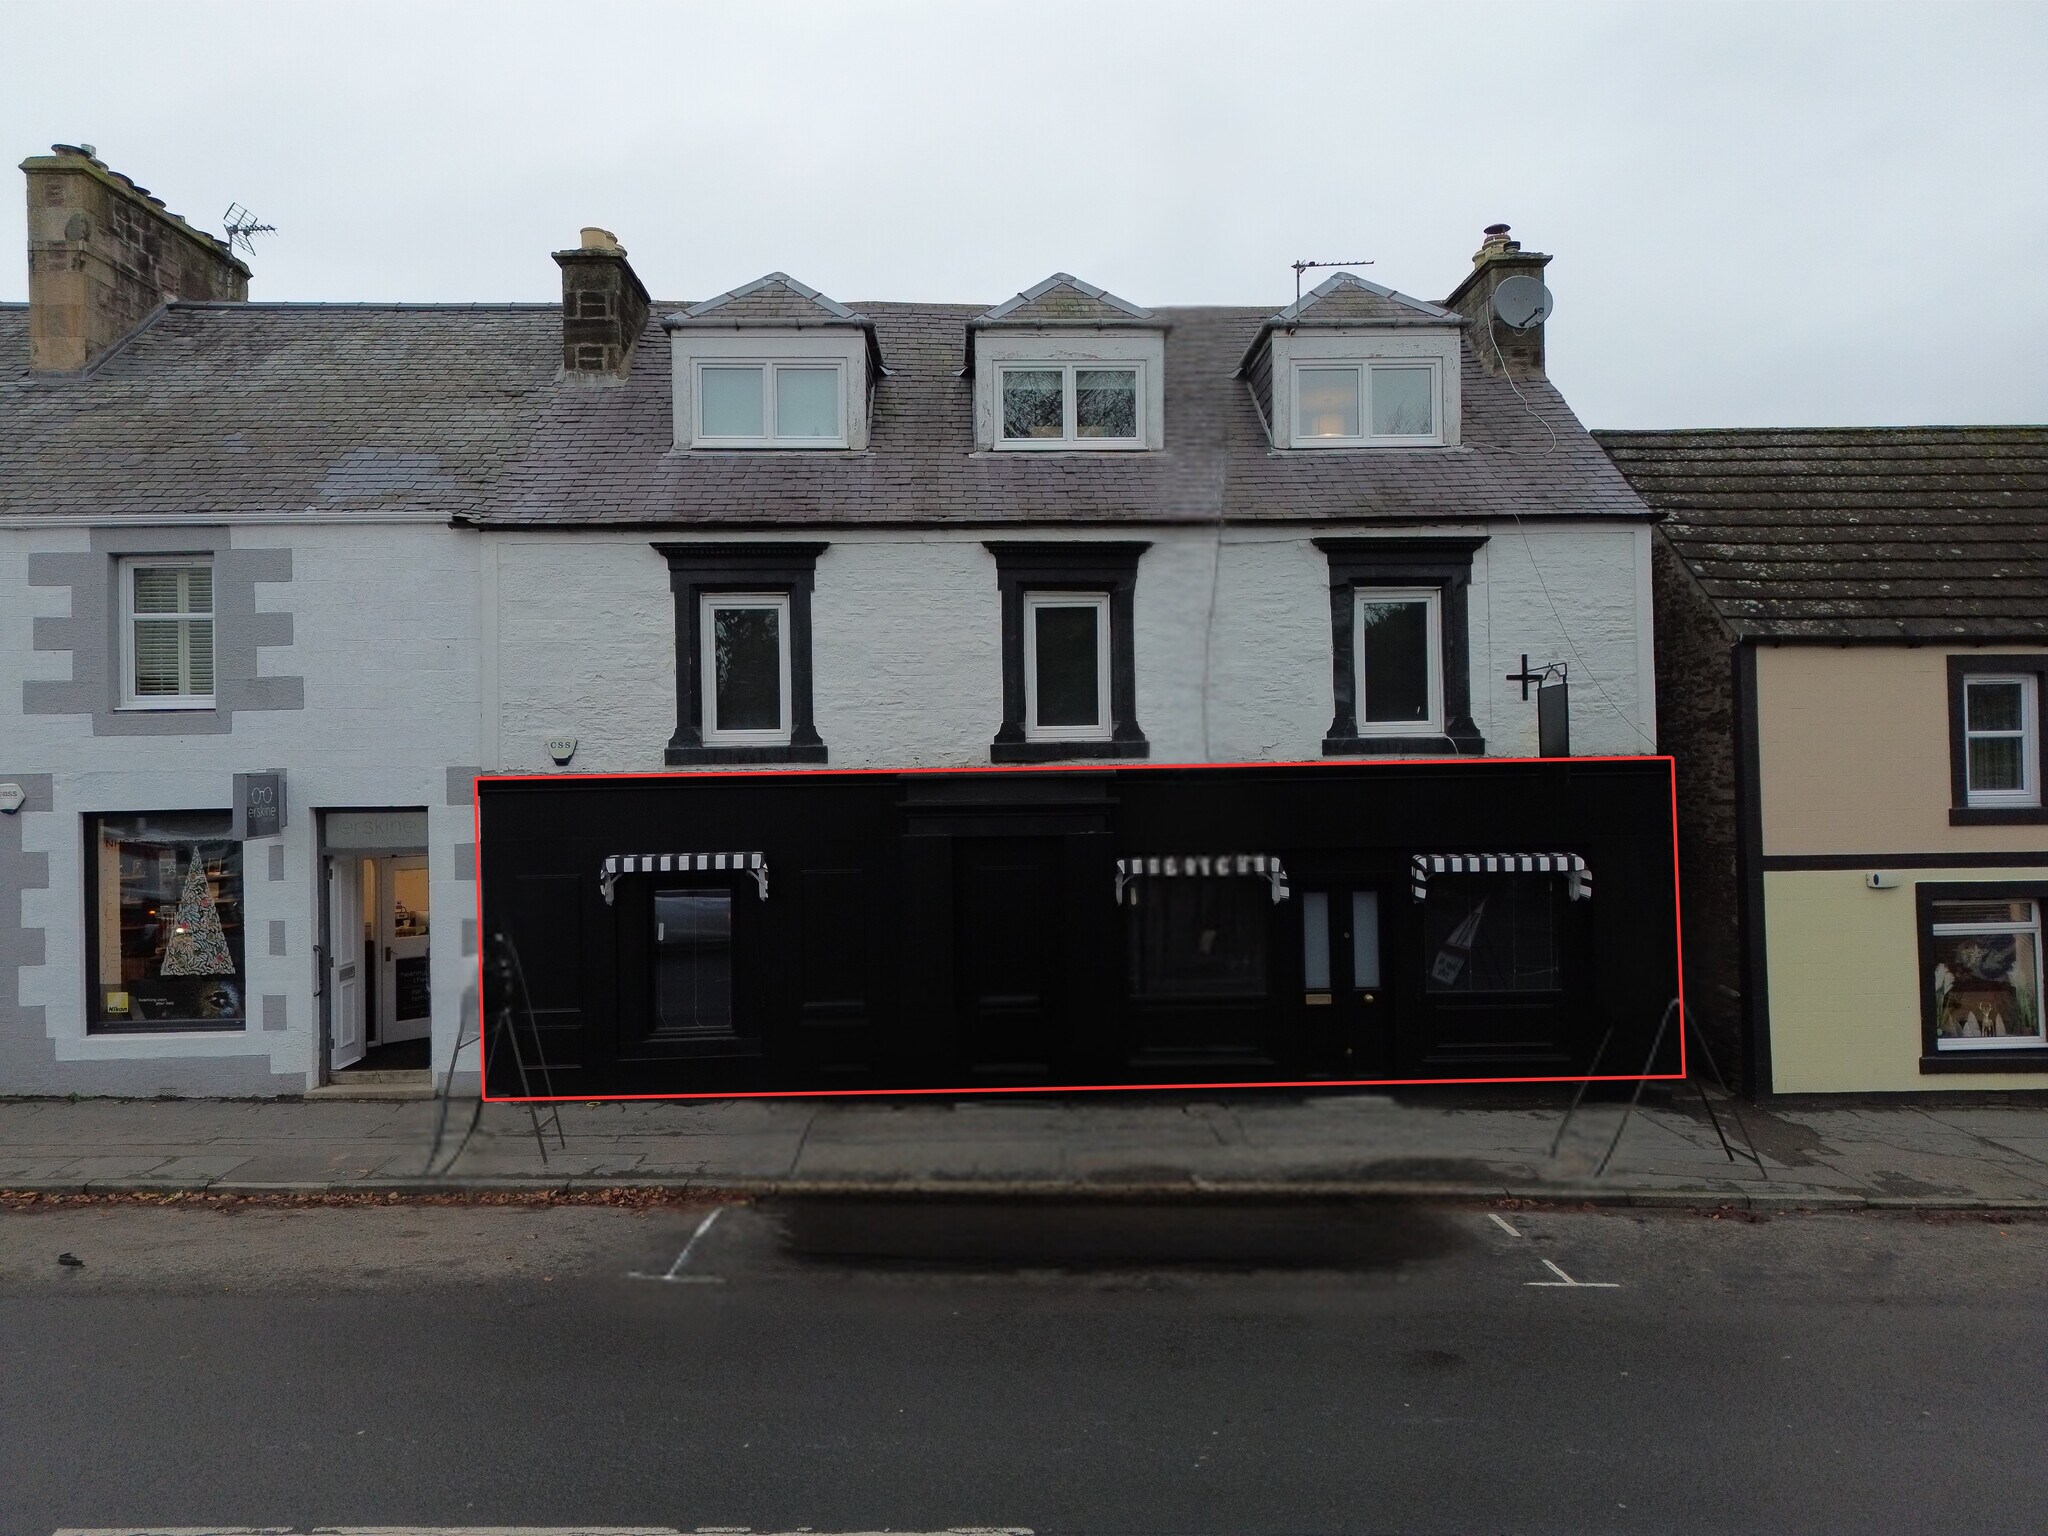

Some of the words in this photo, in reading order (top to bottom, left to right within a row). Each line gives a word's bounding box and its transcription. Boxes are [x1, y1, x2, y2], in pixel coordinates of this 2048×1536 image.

[550, 741, 571, 749] CSS
[248, 806, 277, 818] erskine
[340, 818, 417, 835] erskine
